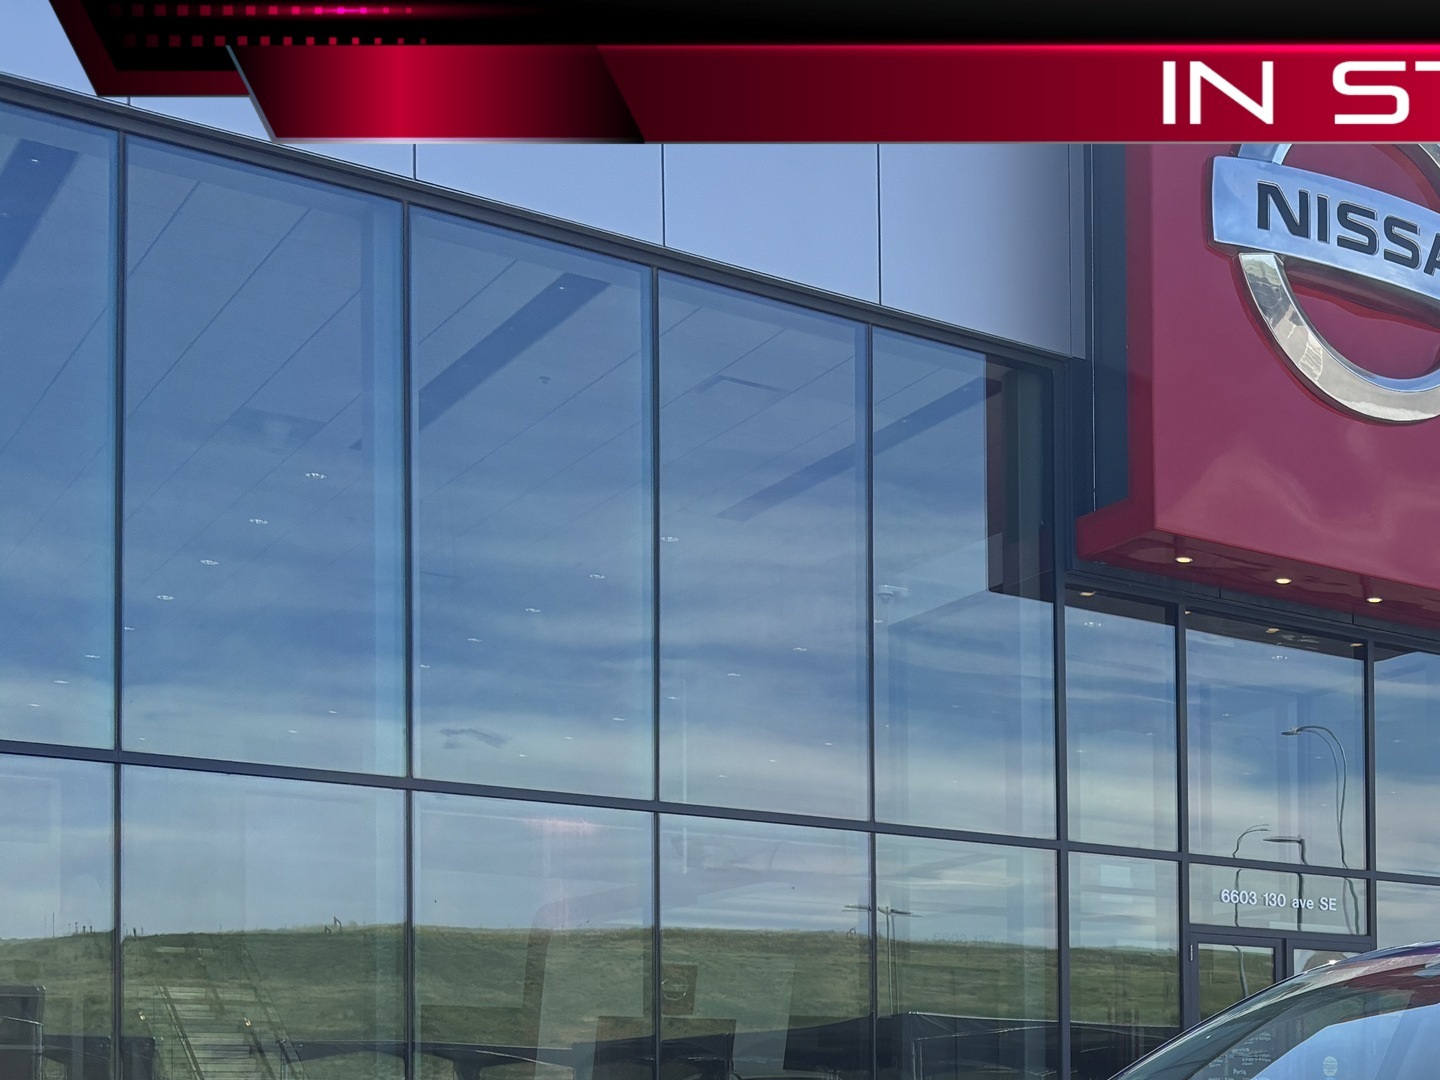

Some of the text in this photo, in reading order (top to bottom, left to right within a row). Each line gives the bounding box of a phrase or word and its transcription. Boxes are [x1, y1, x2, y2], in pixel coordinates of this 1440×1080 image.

[1220, 889, 1337, 911] 6603 130 ave SE
